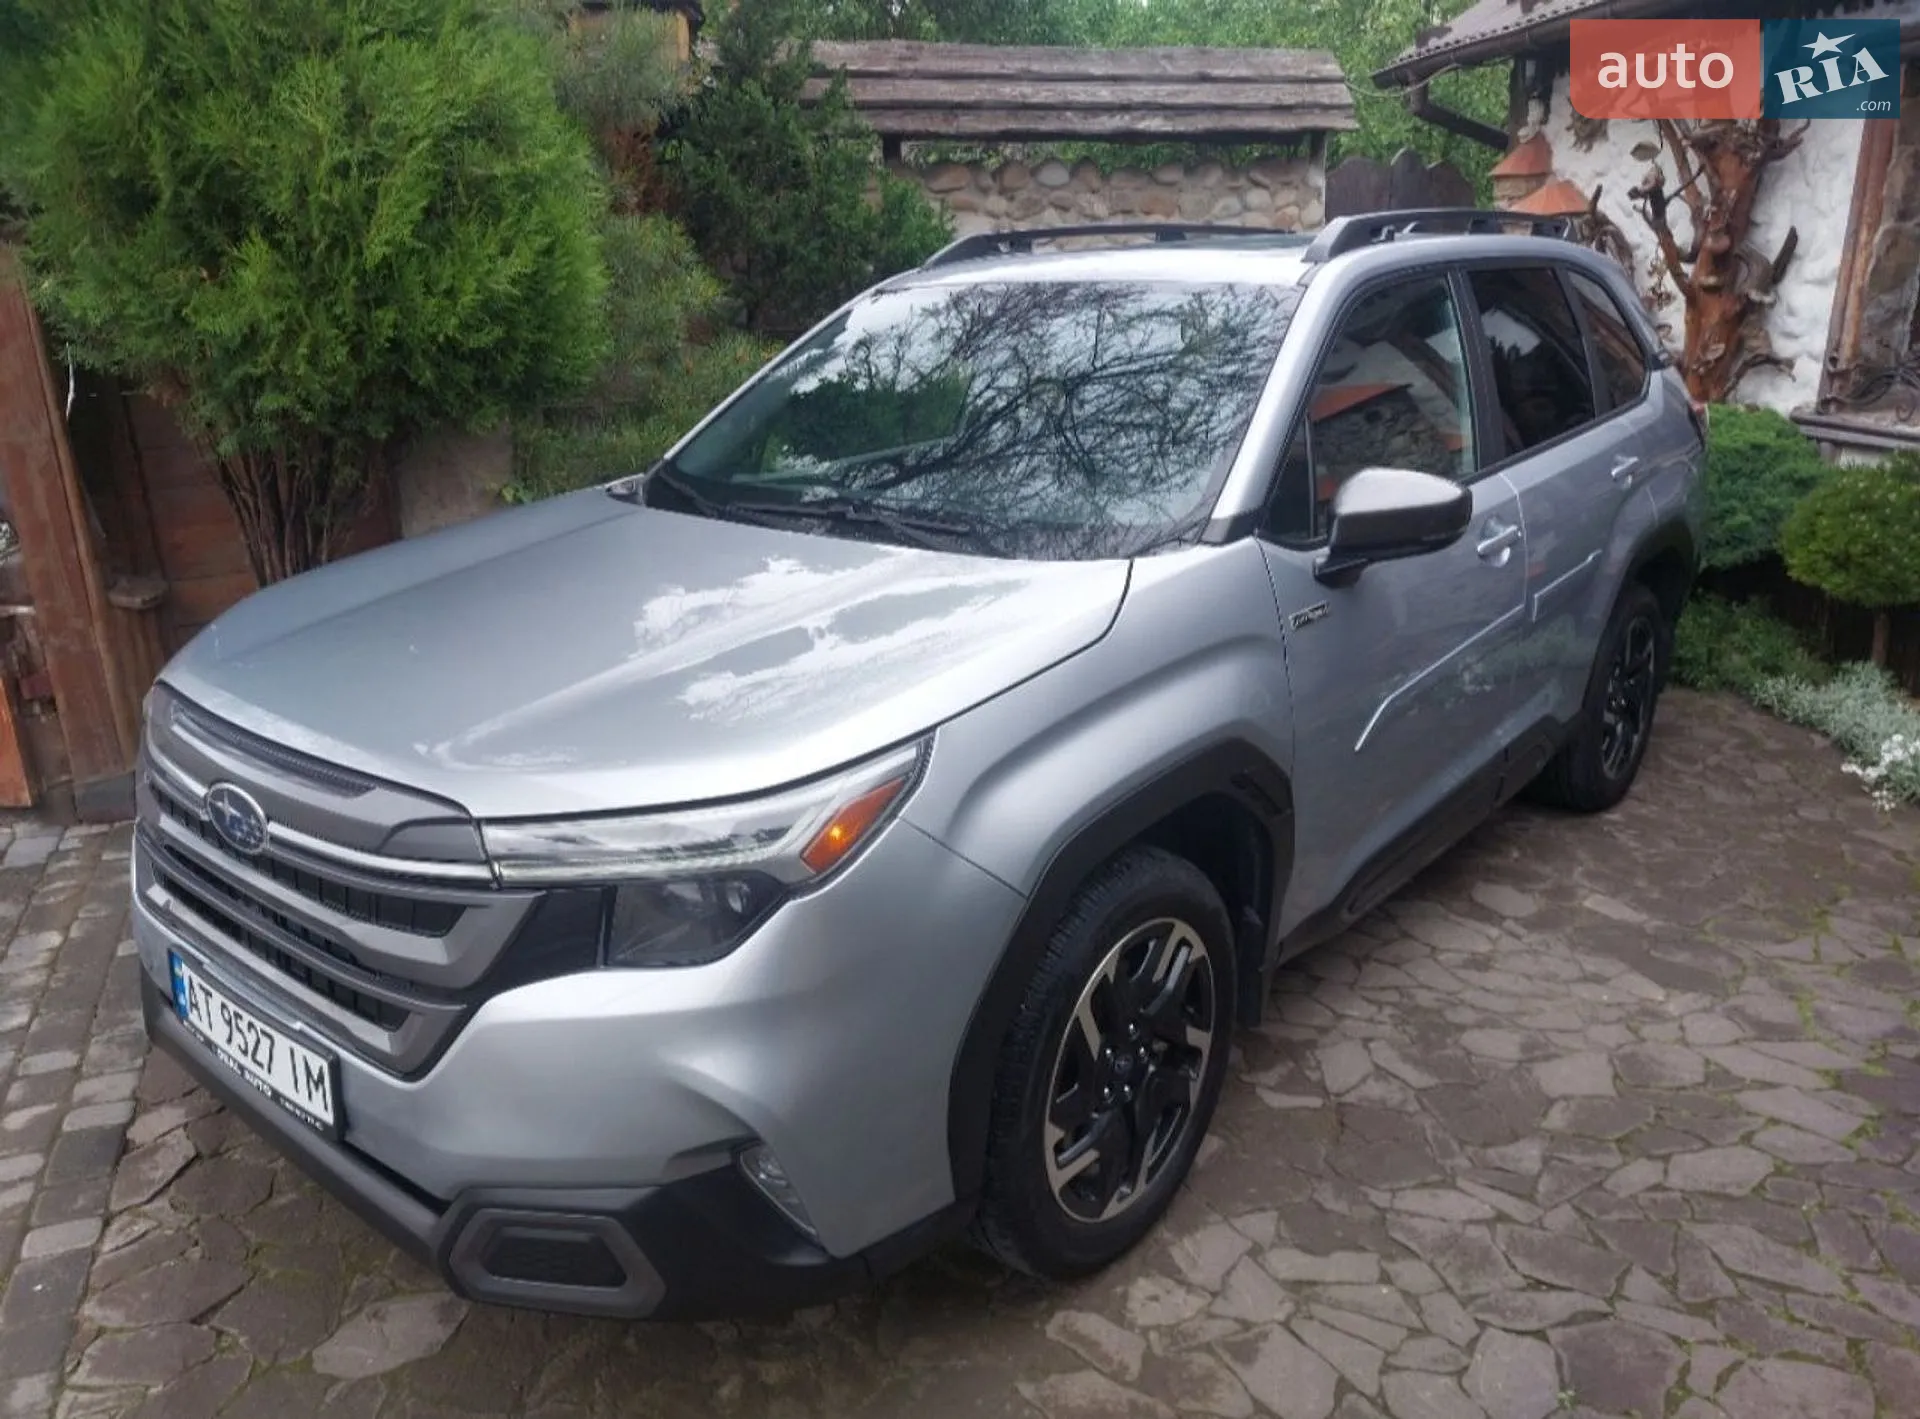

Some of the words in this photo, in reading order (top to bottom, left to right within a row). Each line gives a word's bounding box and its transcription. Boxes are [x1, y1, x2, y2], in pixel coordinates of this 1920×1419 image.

[188, 974, 213, 1033] AT
[220, 1001, 275, 1075] 9527
[289, 1046, 329, 1112] IM
